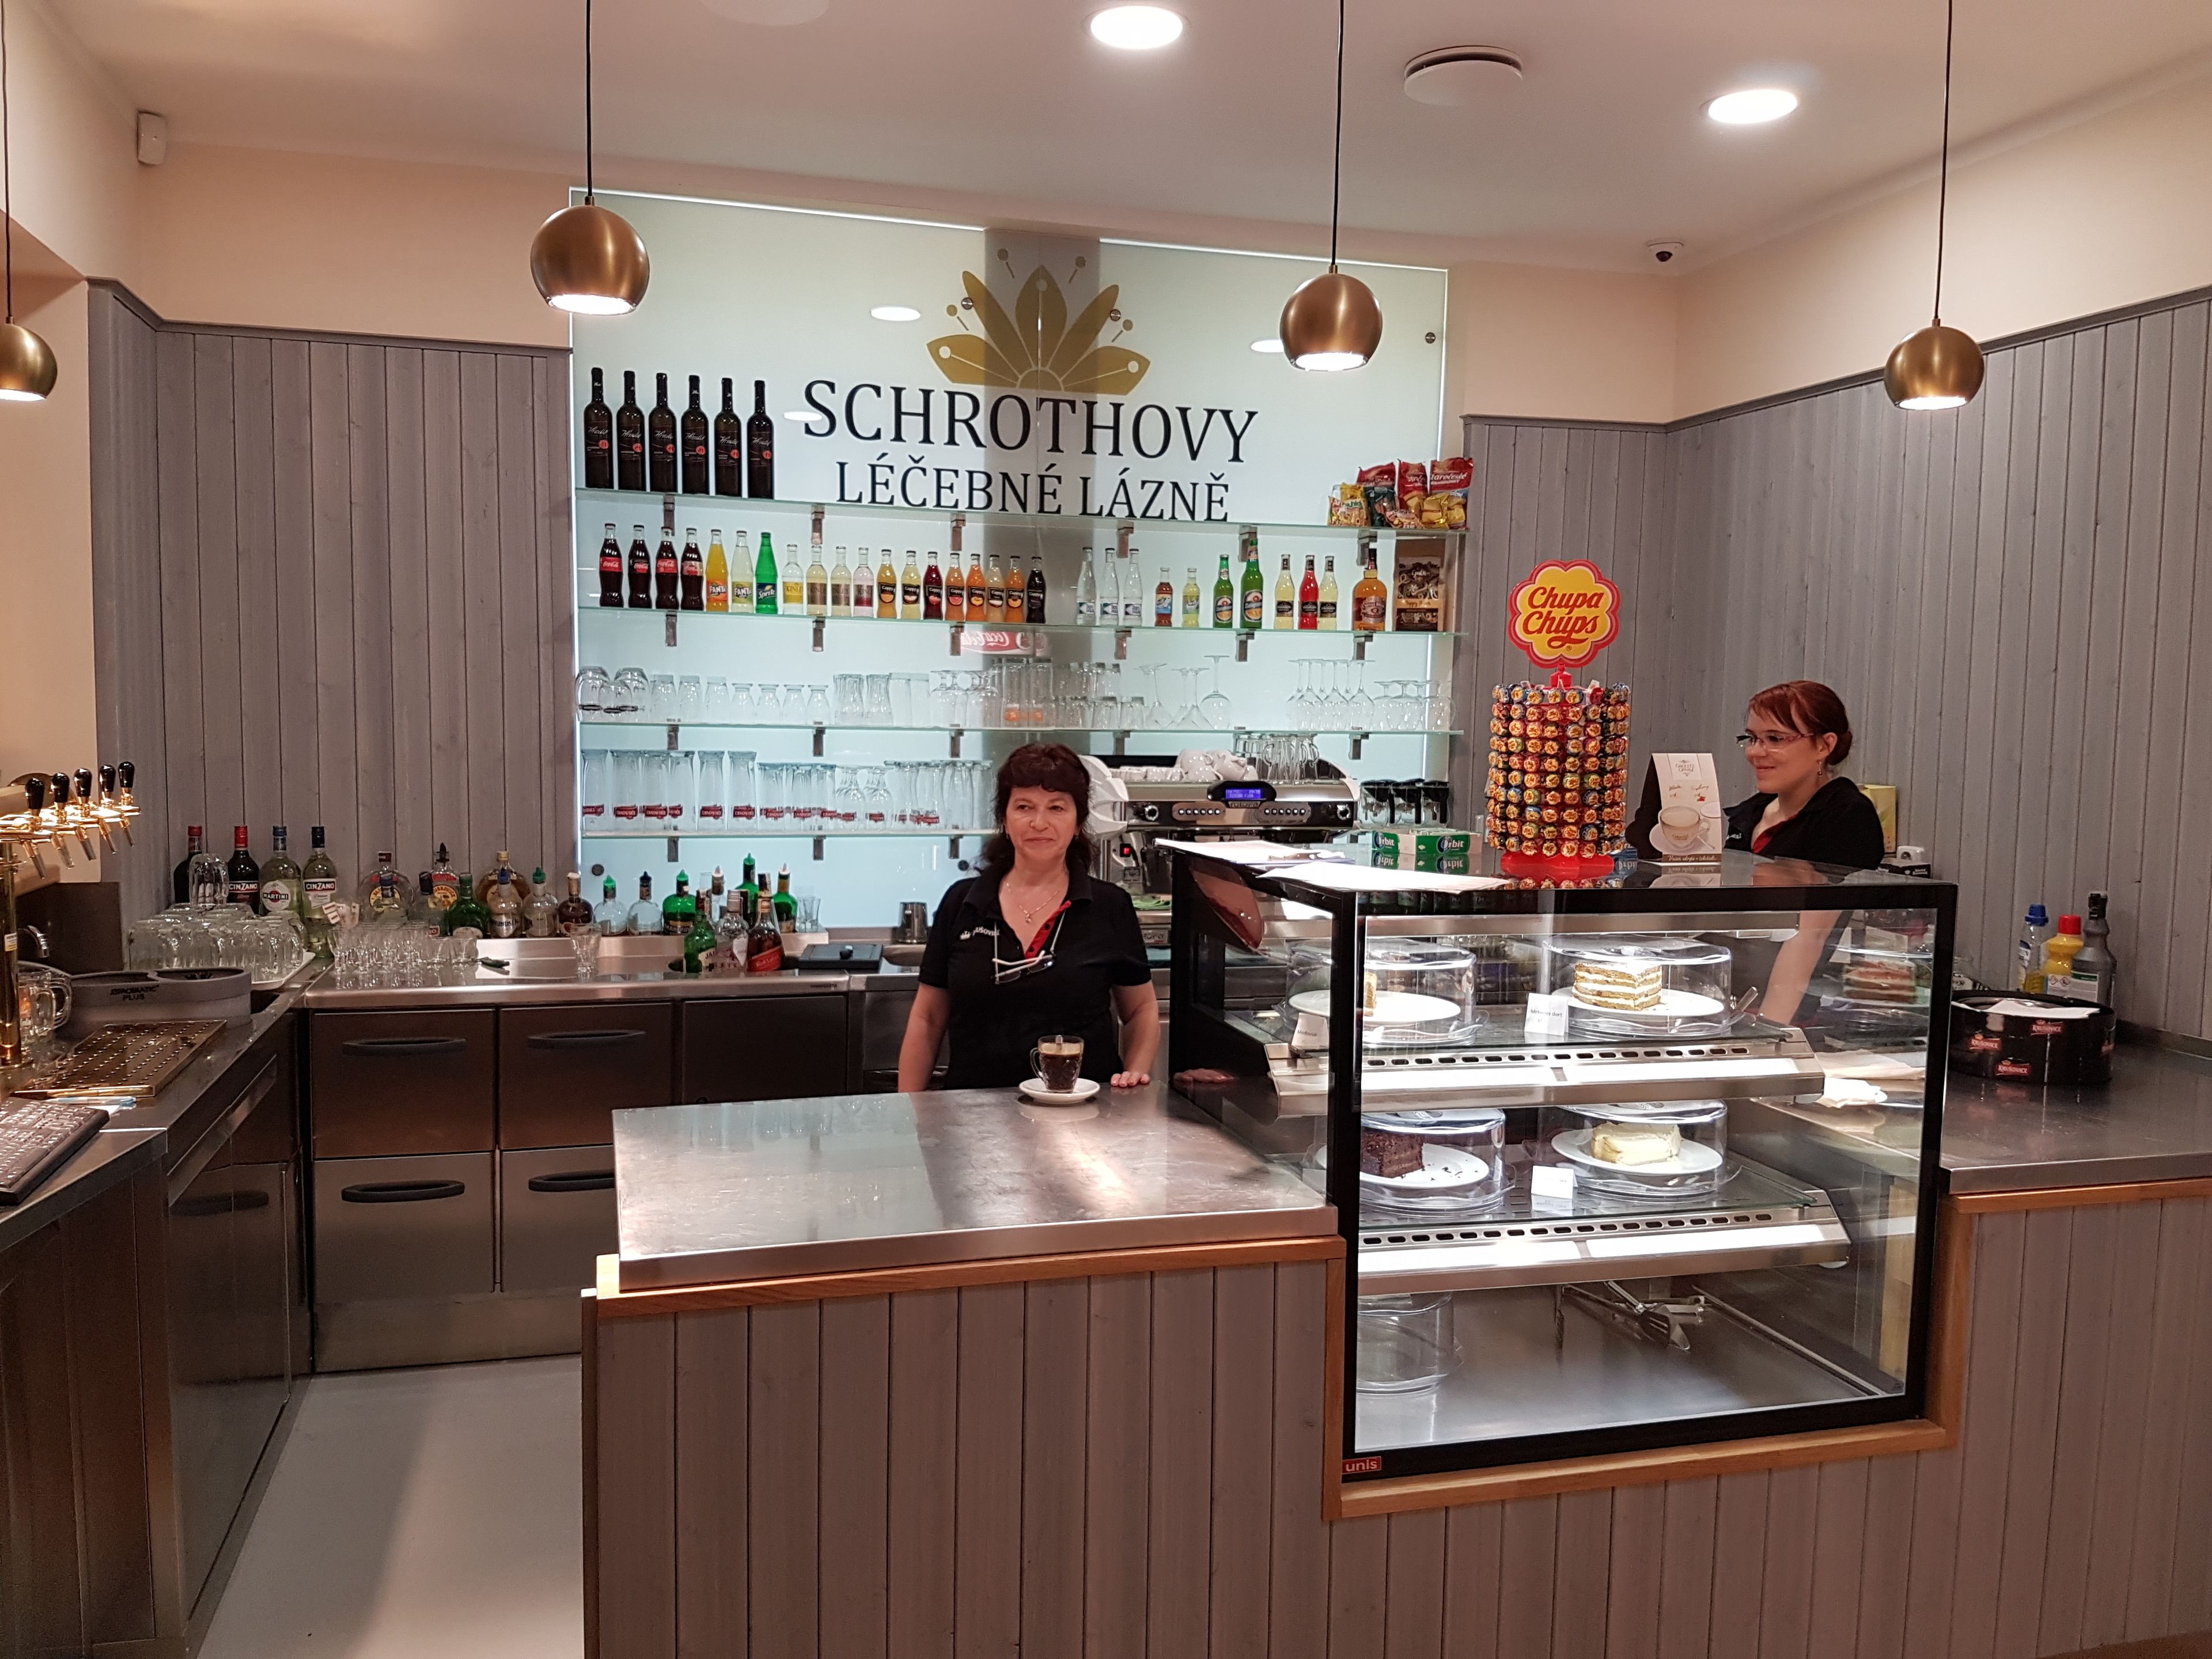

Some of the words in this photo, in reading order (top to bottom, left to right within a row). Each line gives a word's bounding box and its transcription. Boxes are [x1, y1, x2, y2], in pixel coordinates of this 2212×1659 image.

[804, 379, 1259, 464] SCHROTHOVY
[1431, 471, 1467, 482] taročeské
[835, 452, 1062, 515] LÉČEBNÉ
[1078, 467, 1230, 522] LÁZNĚ
[757, 589, 775, 600] Sprite
[1528, 586, 1604, 615] Chupa
[1522, 610, 1599, 649] Chups
[1374, 835, 1395, 848] Orbit
[1440, 839, 1464, 851] Orbit
[1346, 1459, 1377, 1472] unis
